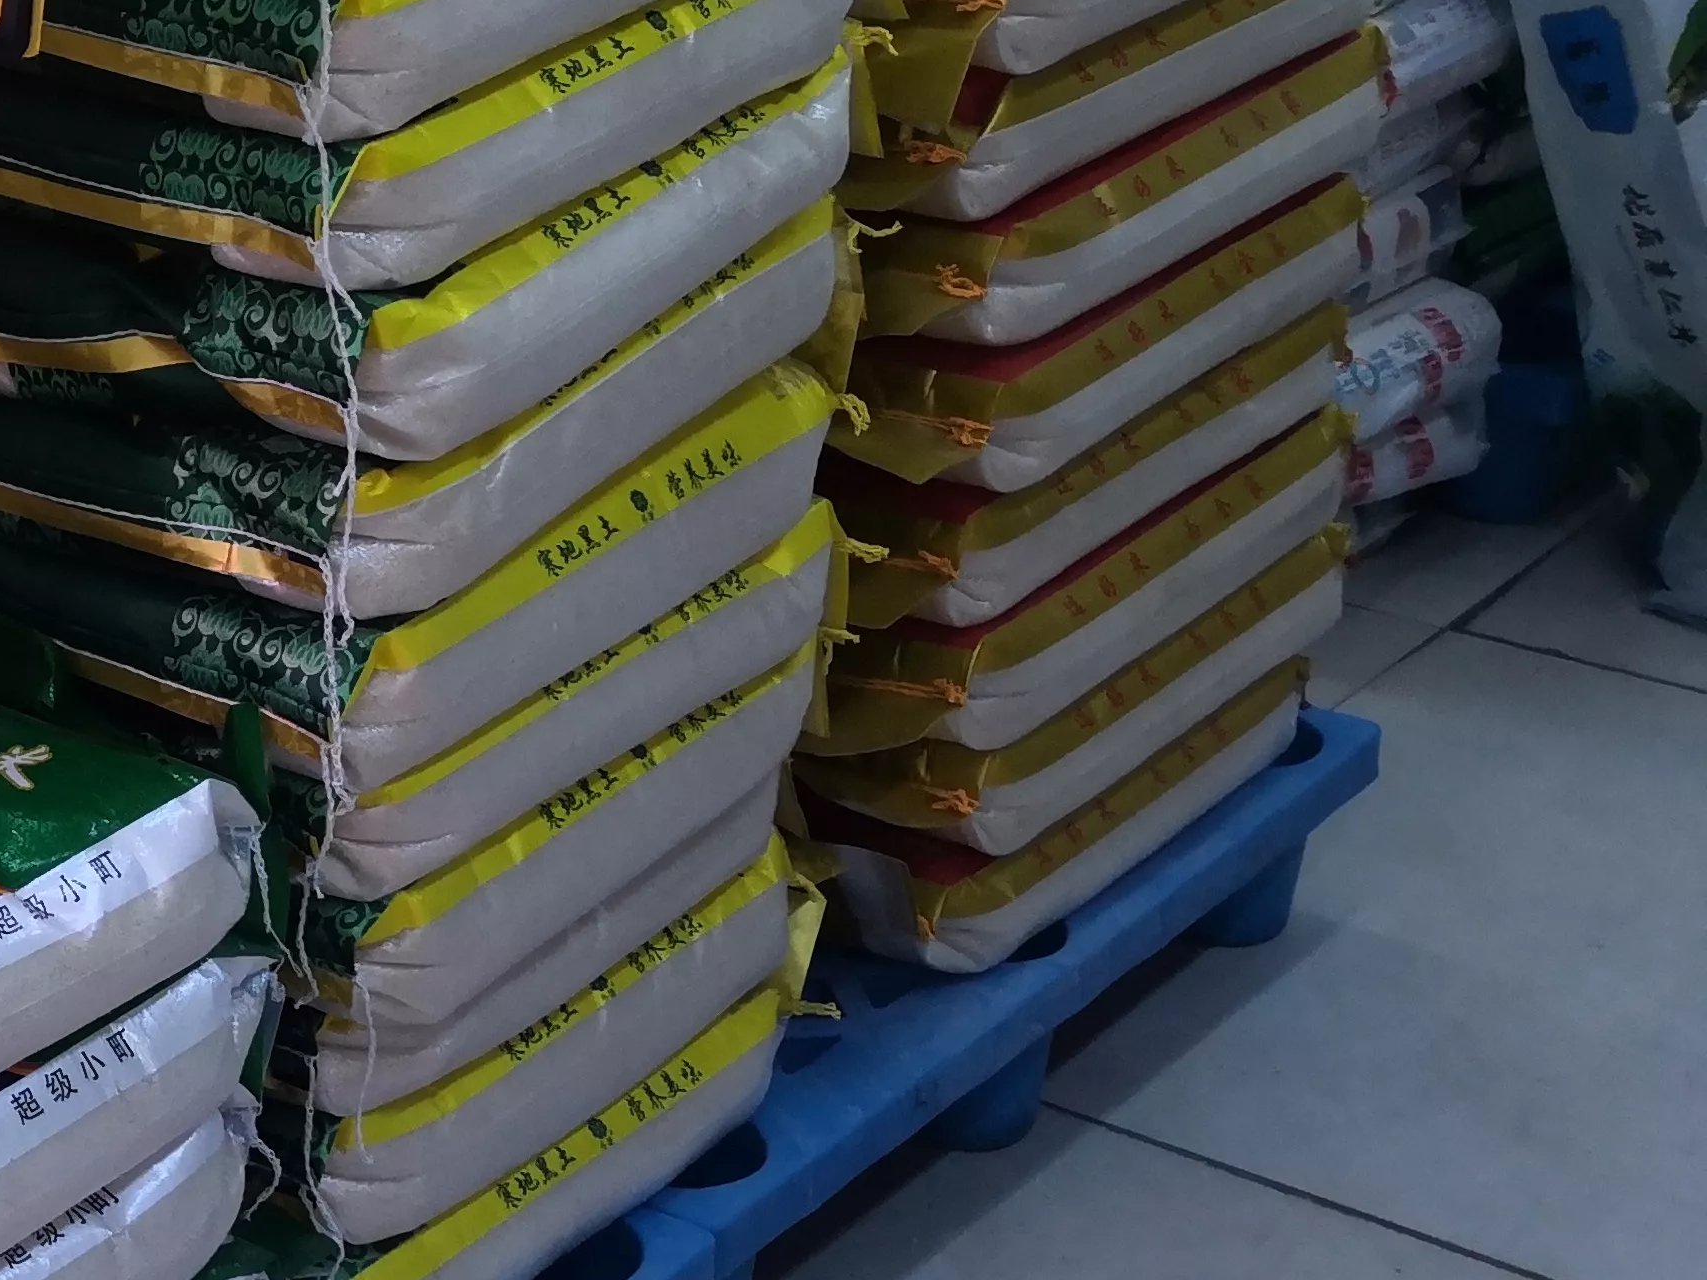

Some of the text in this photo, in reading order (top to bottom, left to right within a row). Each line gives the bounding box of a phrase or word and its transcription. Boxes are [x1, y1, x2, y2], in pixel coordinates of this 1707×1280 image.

[539, 36, 635, 94] 寒地黑土
[541, 187, 631, 248] 寒地黑土
[537, 515, 620, 577] 寒地黑土
[10, 1027, 135, 1125] 超级小町
[494, 1145, 577, 1210] 寒地黑土
